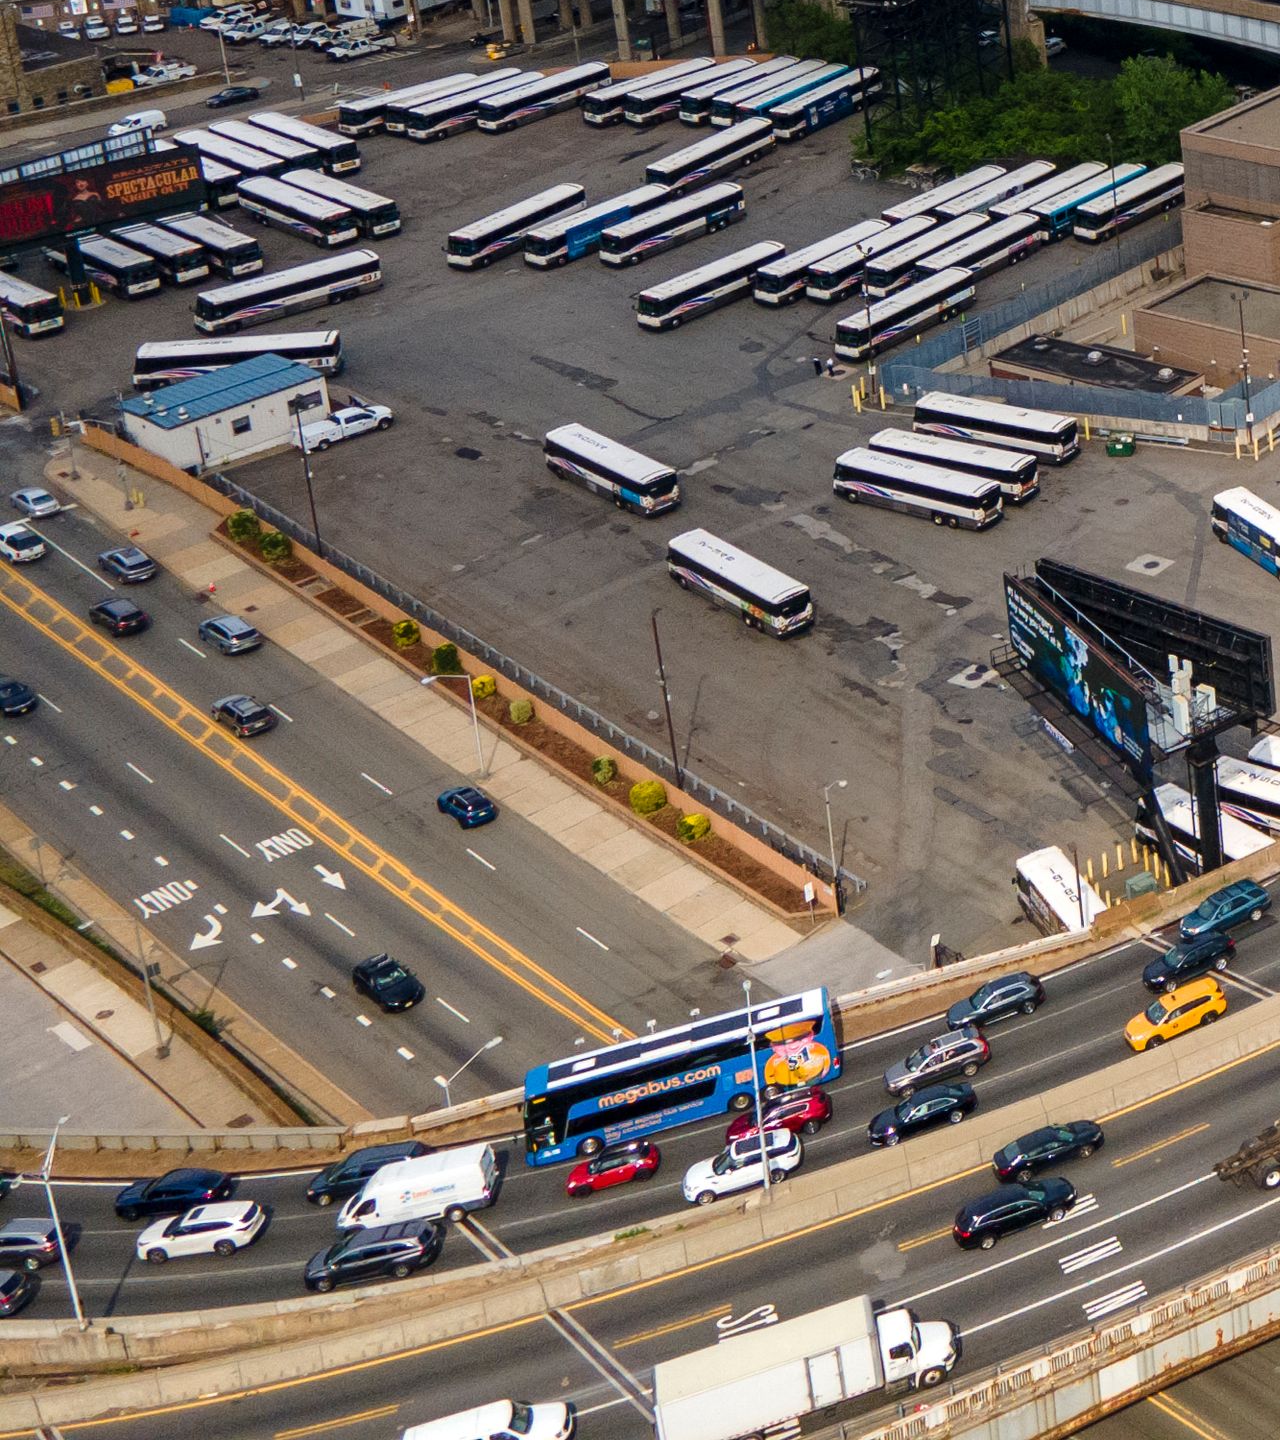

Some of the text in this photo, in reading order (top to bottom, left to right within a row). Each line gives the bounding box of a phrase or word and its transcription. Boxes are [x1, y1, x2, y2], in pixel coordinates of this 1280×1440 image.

[106, 166, 198, 199] SPECTACULAR
[256, 828, 314, 862] ONLY
[134, 881, 194, 919] ONLY
[597, 1065, 721, 1111] megabus.com
